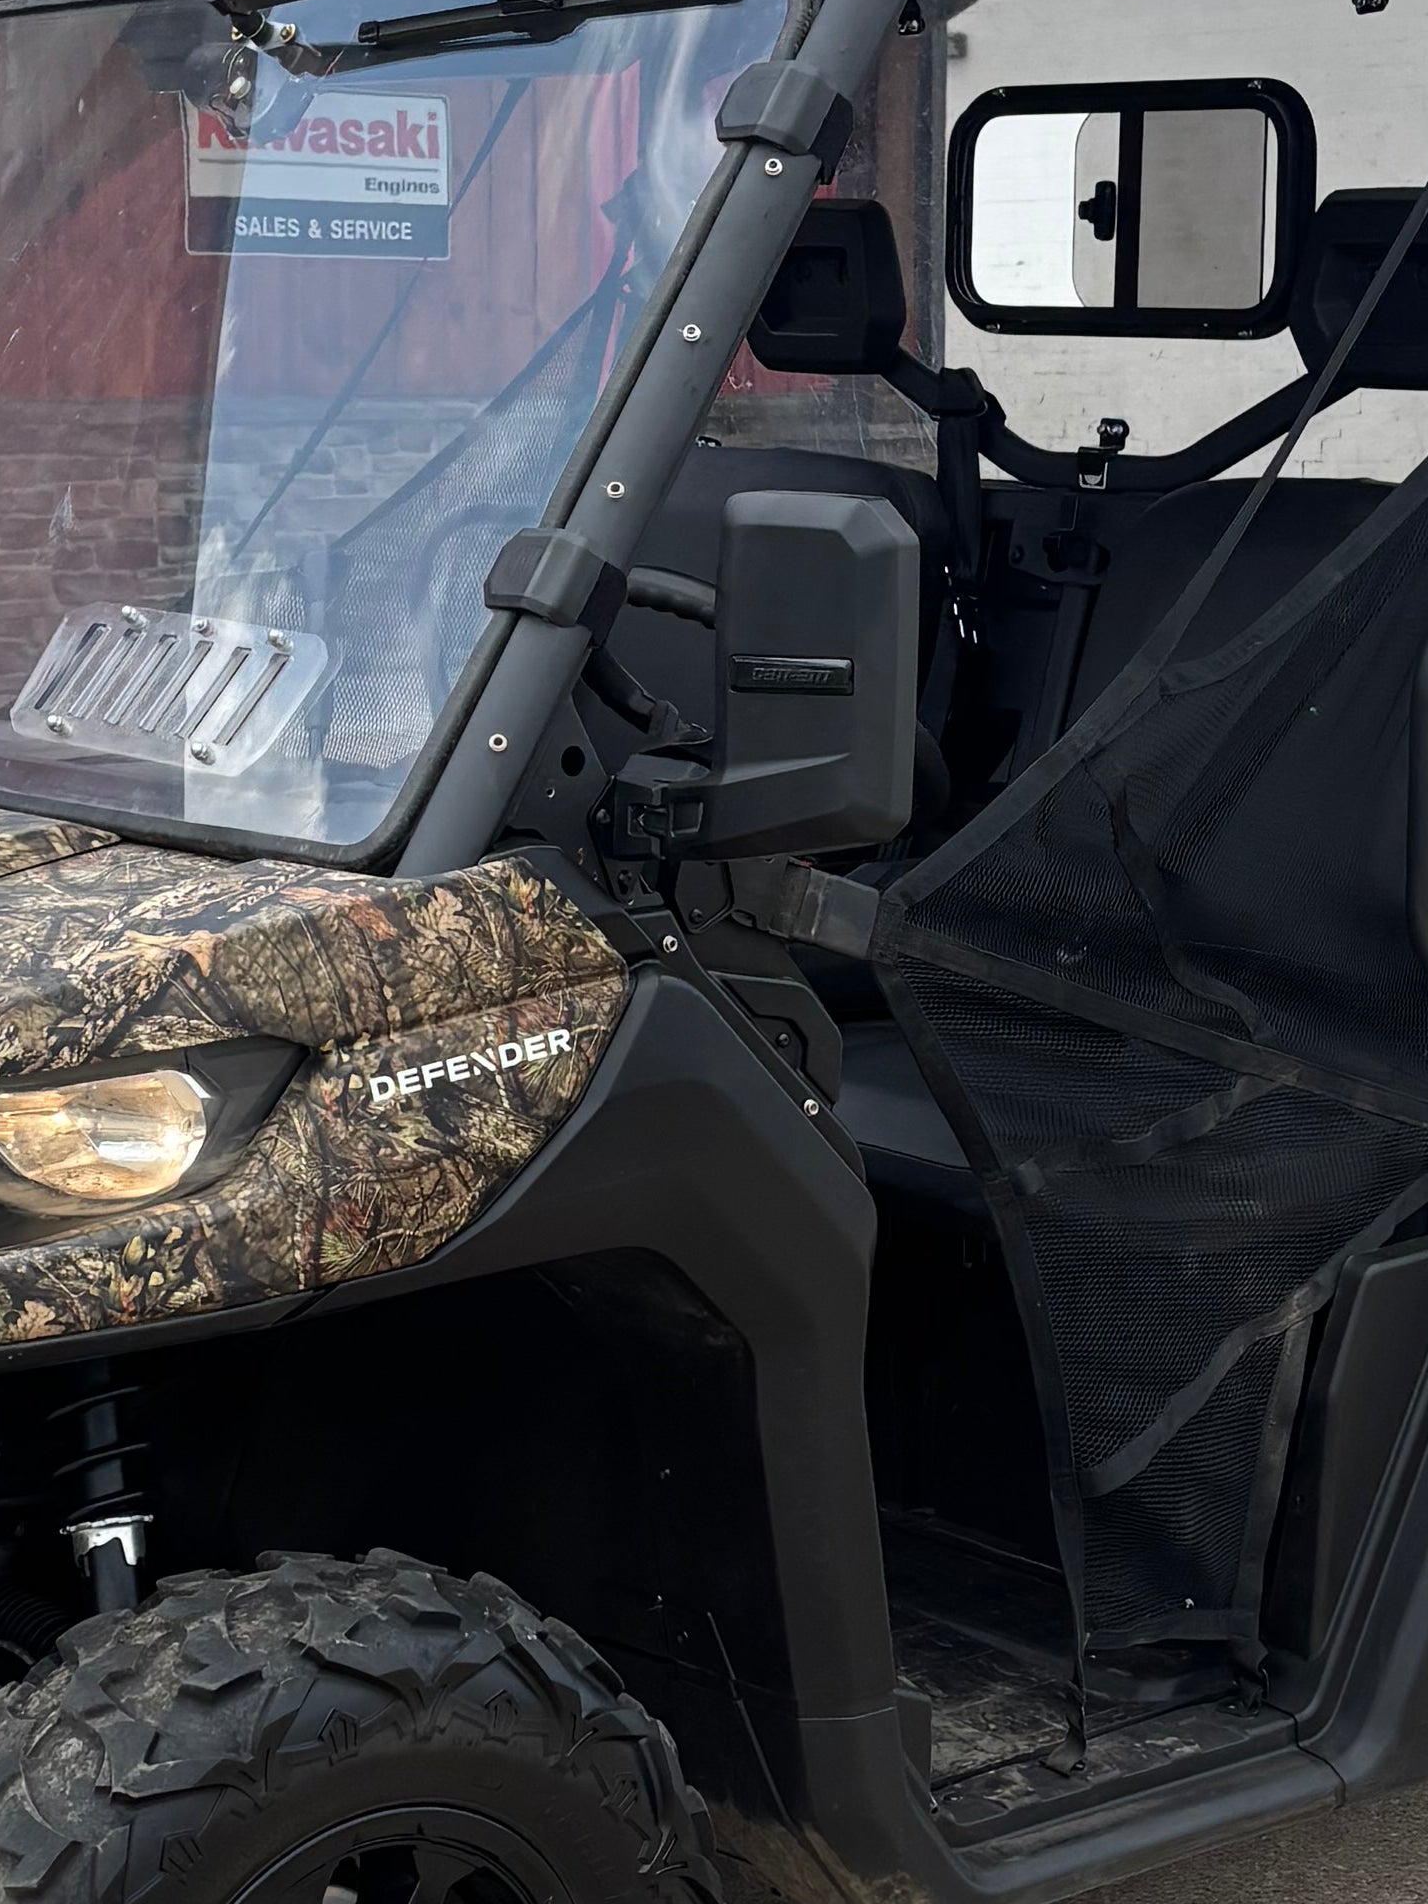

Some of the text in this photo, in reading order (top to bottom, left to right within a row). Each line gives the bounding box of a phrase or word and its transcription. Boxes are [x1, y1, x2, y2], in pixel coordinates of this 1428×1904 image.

[197, 110, 440, 160] Kwasaki
[364, 176, 440, 196] Engines
[235, 215, 413, 241] SALES & SERVICE
[369, 1028, 573, 1103] DEFENDER
